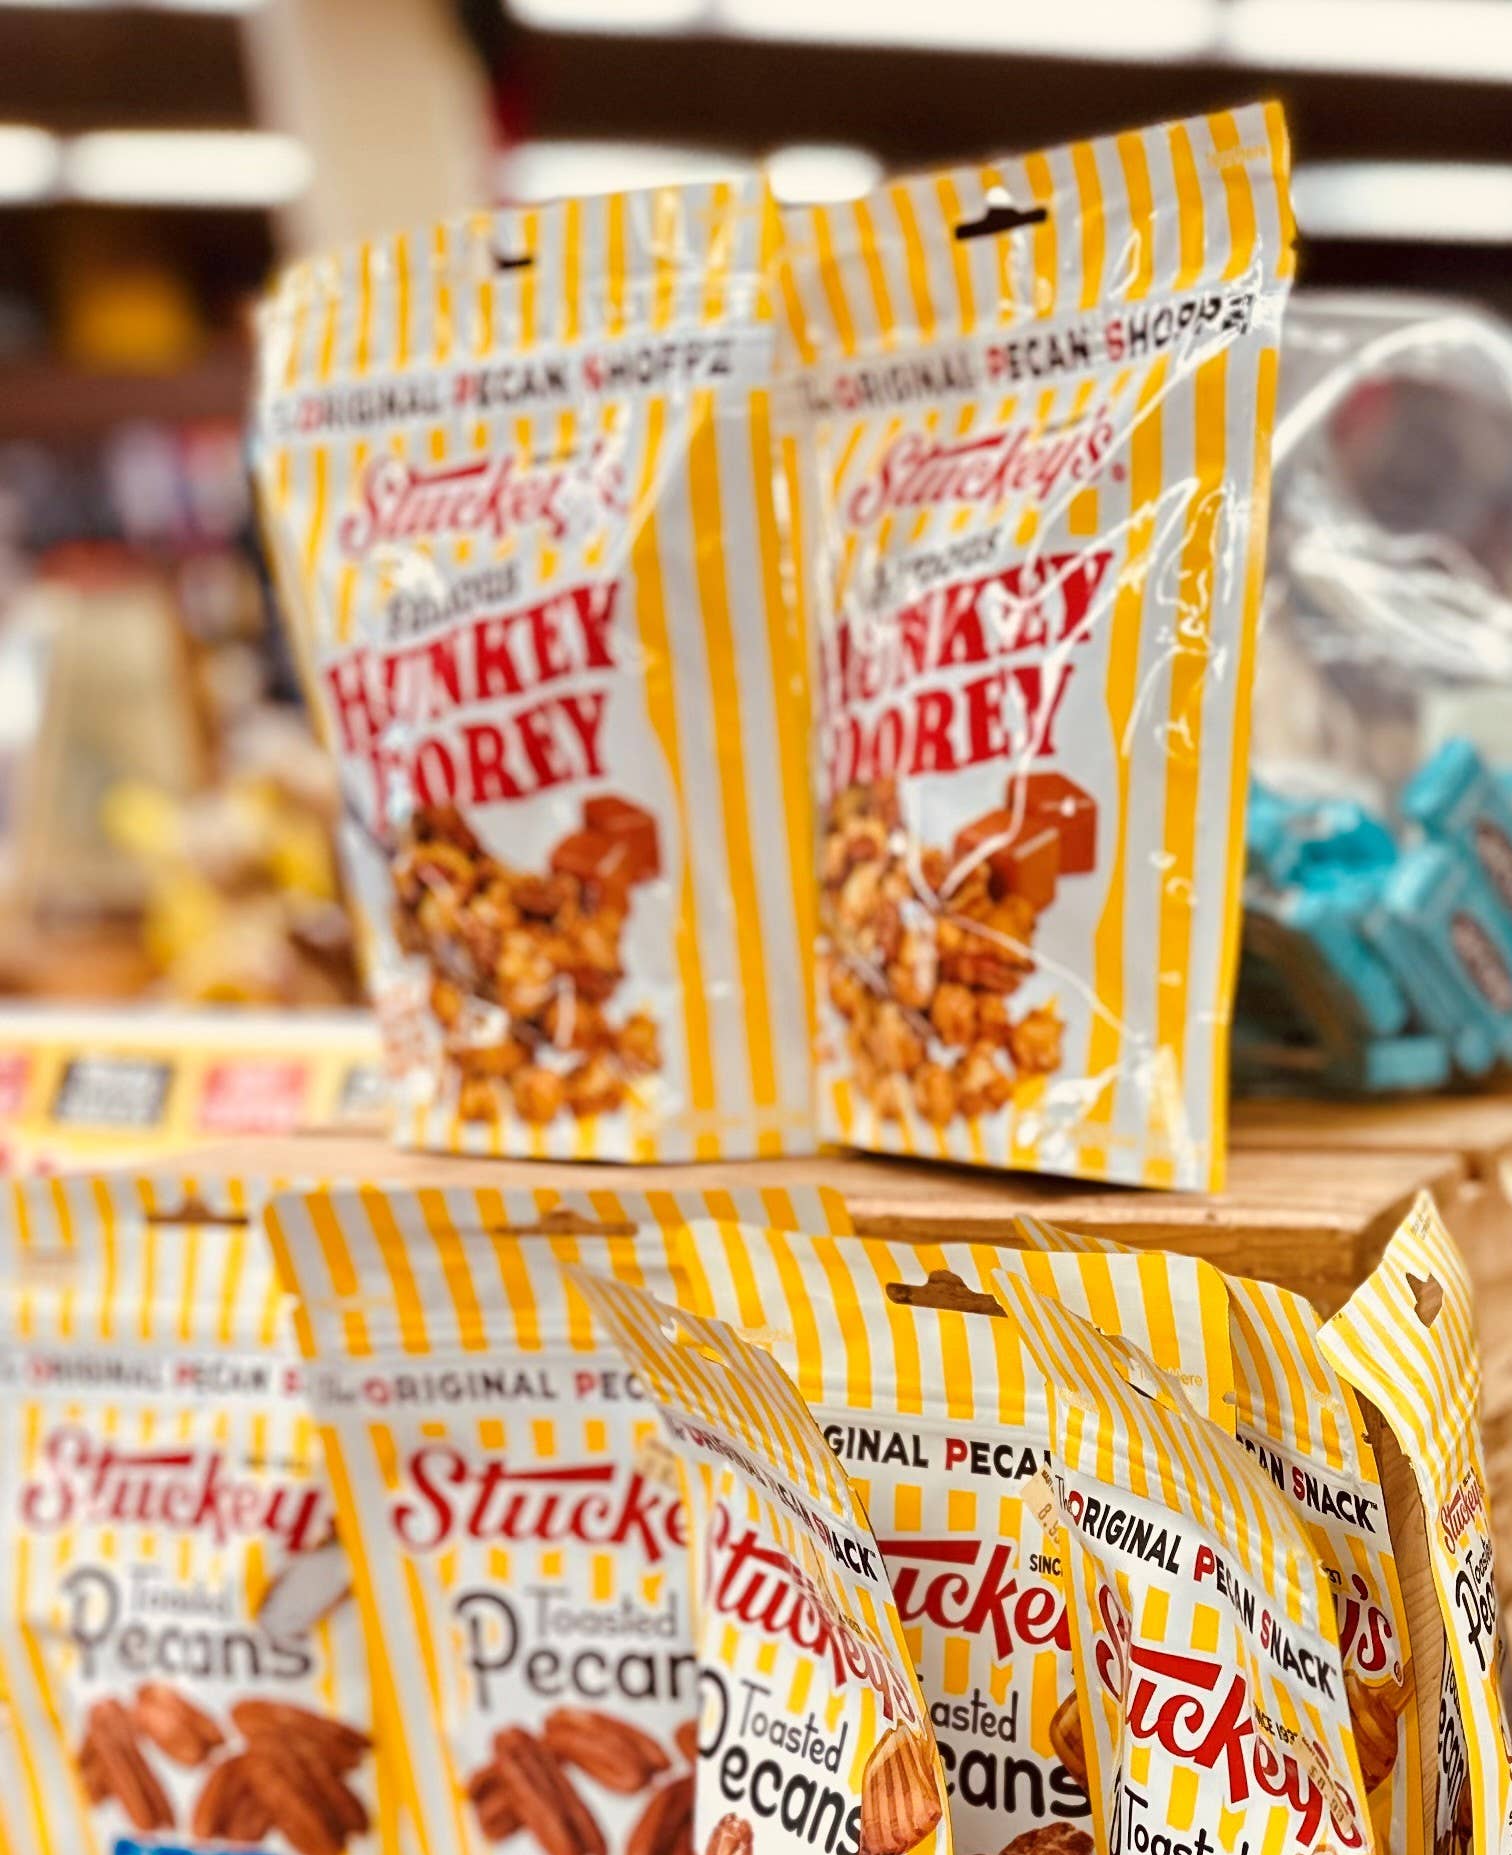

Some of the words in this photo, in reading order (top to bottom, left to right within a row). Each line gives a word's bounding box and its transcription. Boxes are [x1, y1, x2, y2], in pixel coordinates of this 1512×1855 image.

[1292, 1466, 1376, 1534] SNACK
[1068, 1490, 1184, 1575] ORIGINAL
[1194, 1544, 1256, 1636] PECAN
[1261, 1609, 1337, 1701] SNACK
[738, 1679, 848, 1775] Toasted
